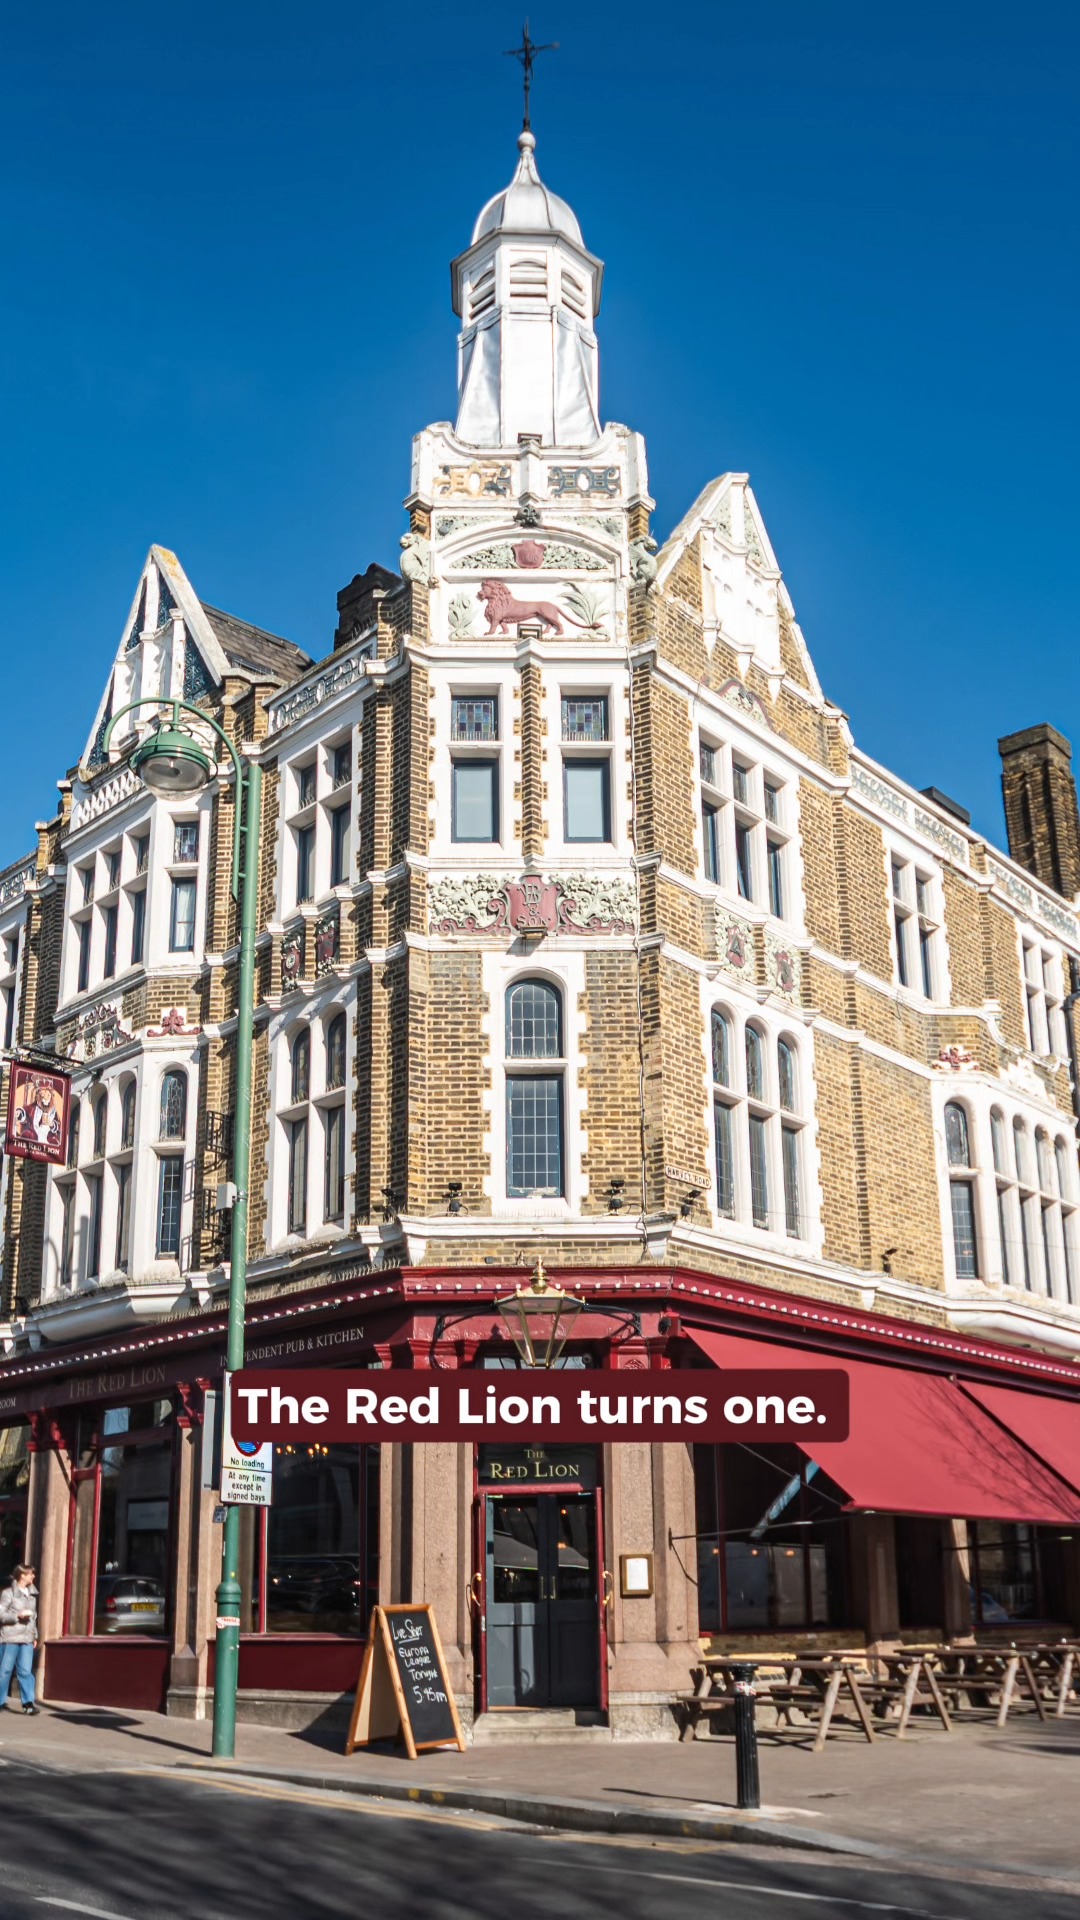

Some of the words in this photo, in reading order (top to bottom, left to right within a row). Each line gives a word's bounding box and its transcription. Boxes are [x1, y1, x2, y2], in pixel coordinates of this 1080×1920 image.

[667, 1167, 691, 1181] HARVEY
[694, 1175, 709, 1186] ROAD
[286, 1339, 305, 1354] PUB
[307, 1337, 314, 1349] &
[316, 1327, 365, 1348] KITCHEN
[69, 1377, 94, 1399] THE
[97, 1373, 126, 1393] RED
[129, 1364, 167, 1388] LION
[524, 1449, 545, 1459] THE
[231, 1457, 239, 1465] No
[241, 1459, 265, 1469] loading
[490, 1462, 528, 1479] RED
[534, 1461, 580, 1478] LION
[228, 1471, 236, 1479] At
[238, 1474, 249, 1482] any
[252, 1473, 266, 1482] time
[231, 1482, 254, 1491] except
[256, 1483, 262, 1491] in
[227, 1492, 249, 1500] signed
[250, 1493, 266, 1502] bays
